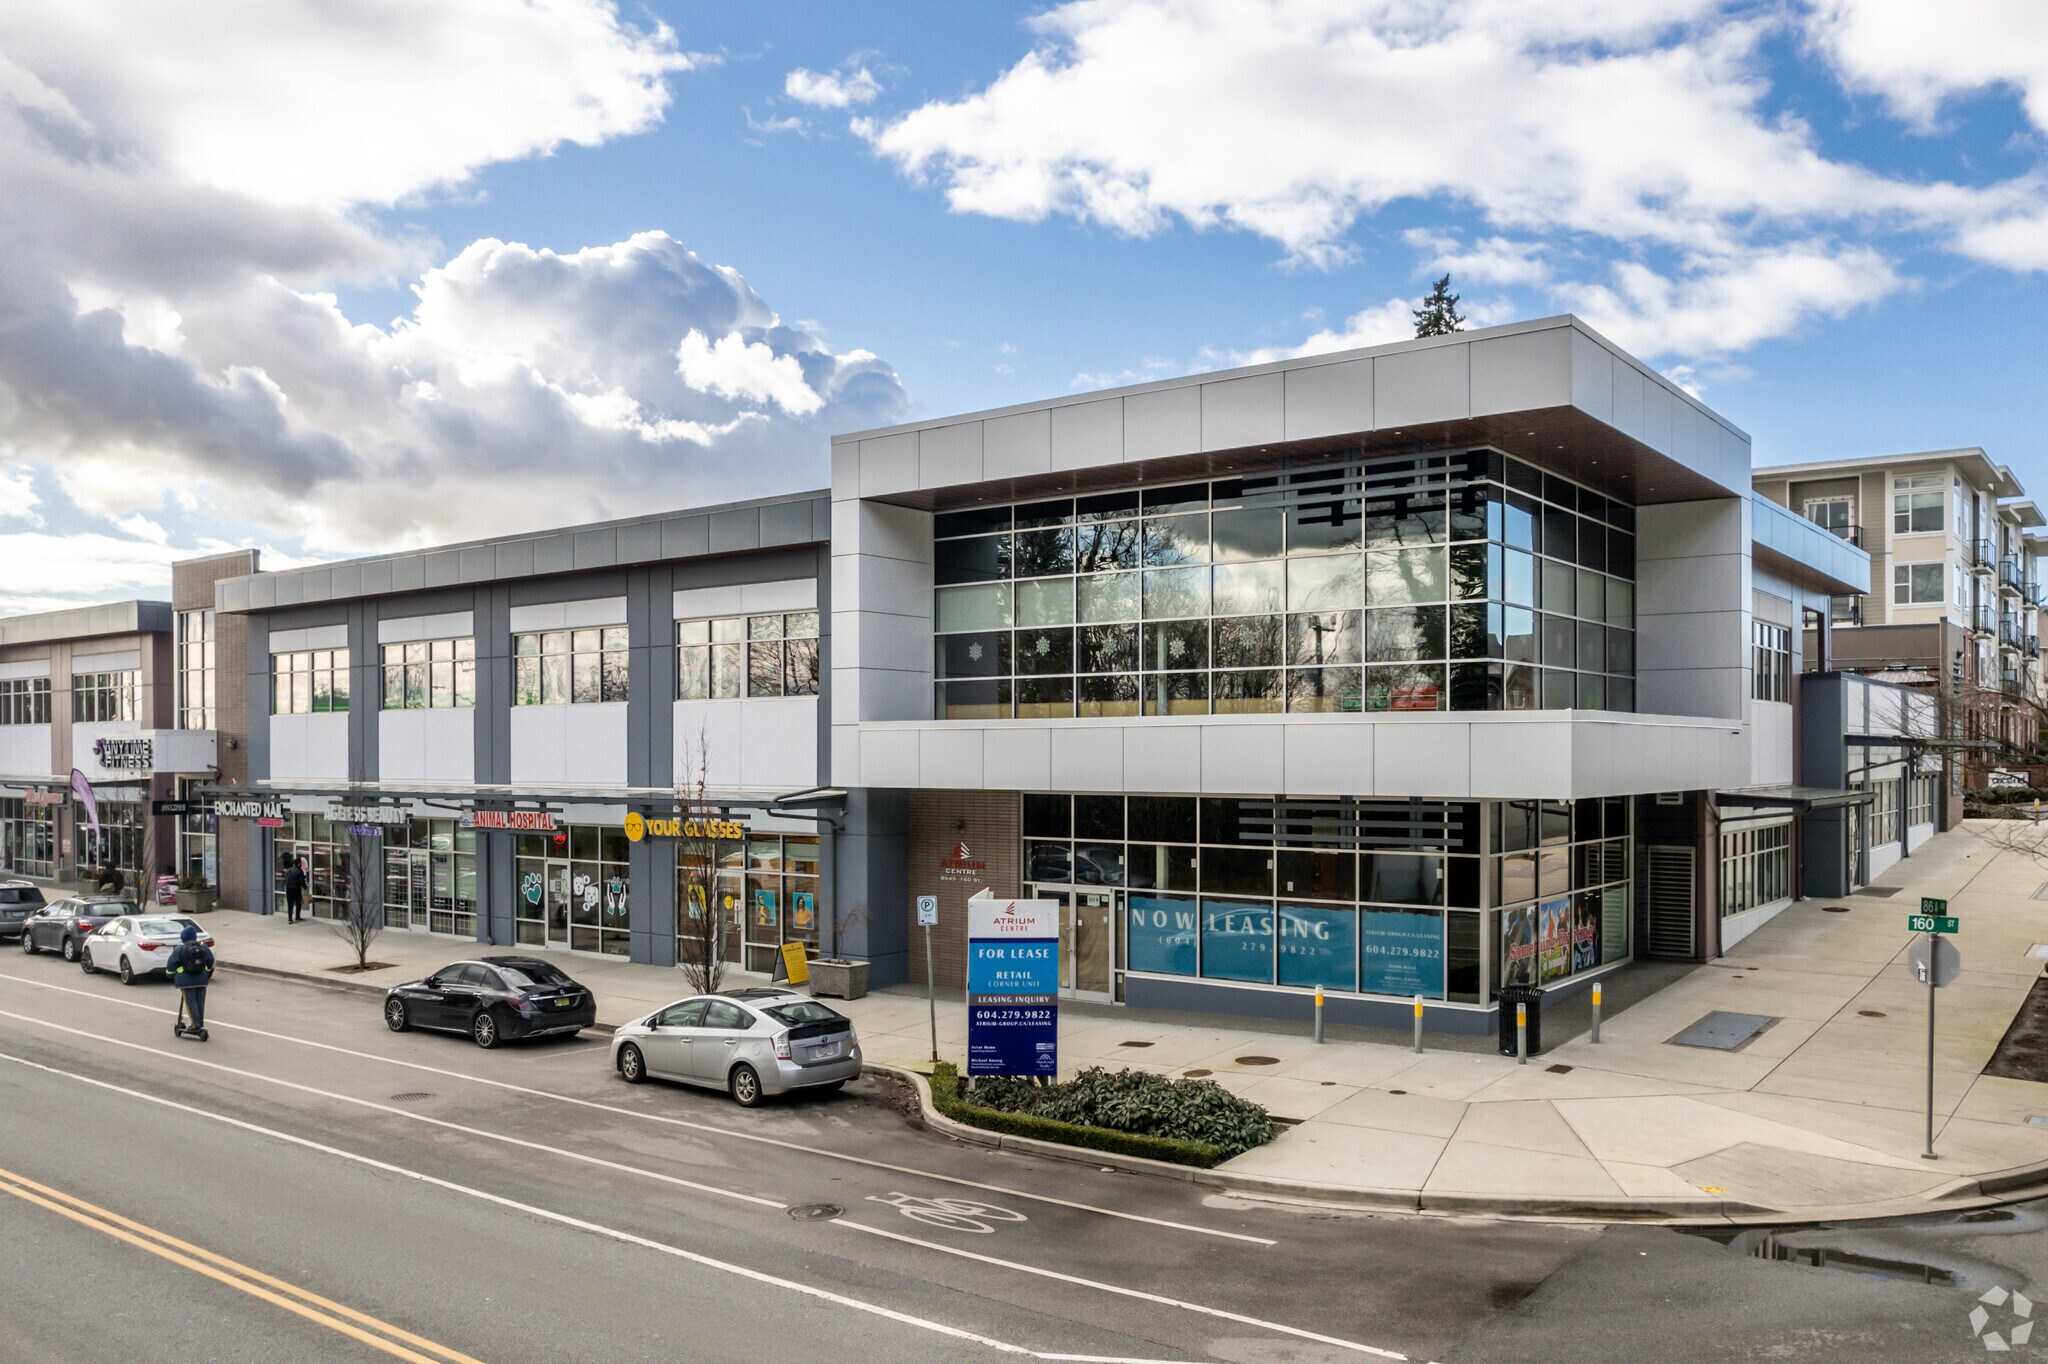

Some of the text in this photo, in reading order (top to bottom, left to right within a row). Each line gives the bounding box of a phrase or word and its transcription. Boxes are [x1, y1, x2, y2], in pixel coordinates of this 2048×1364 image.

[105, 739, 152, 754] ANYTIME
[105, 755, 152, 768] FITNESS
[214, 801, 285, 818] ENCHANTED NAIL
[367, 806, 408, 824] BEAUTY
[475, 811, 553, 830] ANIMAL HOSPITAL
[645, 820, 742, 839] YOUR GLASSES
[940, 859, 985, 869] ATRIUM
[945, 868, 978, 876] CENTRE
[924, 901, 931, 909] P
[1132, 908, 1329, 941] NOW LEASING
[1912, 917, 1955, 930] 160 ST
[979, 948, 1050, 959] FOR LEASE
[1241, 941, 1316, 956] 279.9822
[1366, 944, 1440, 959] 604.279.9822
[996, 971, 1032, 979] RETAIL
[1015, 996, 1050, 1004] INQUIRY
[976, 1010, 1051, 1019] 604.279.9822
